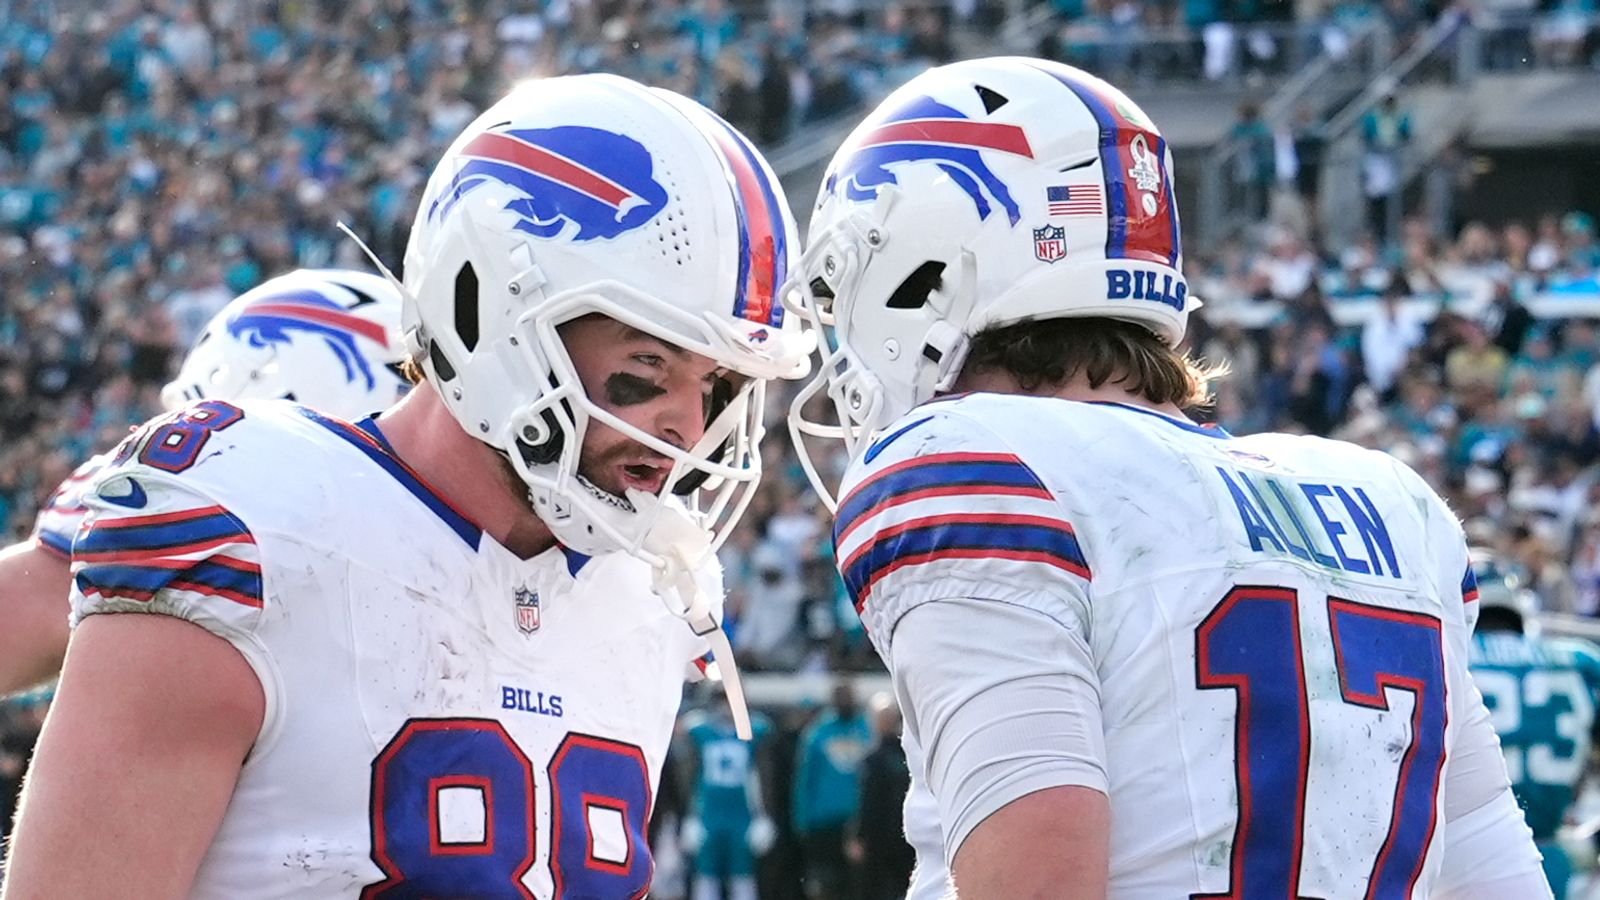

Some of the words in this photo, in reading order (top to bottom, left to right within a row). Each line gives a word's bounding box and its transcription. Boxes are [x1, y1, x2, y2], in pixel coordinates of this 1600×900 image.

[1038, 241, 1064, 260] NFL
[1106, 269, 1187, 312] BILLS
[1215, 466, 1402, 579] ALLEN
[519, 607, 539, 630] NFL
[502, 685, 564, 718] BILLS
[1190, 584, 1448, 900] 17
[359, 717, 656, 900] 88
